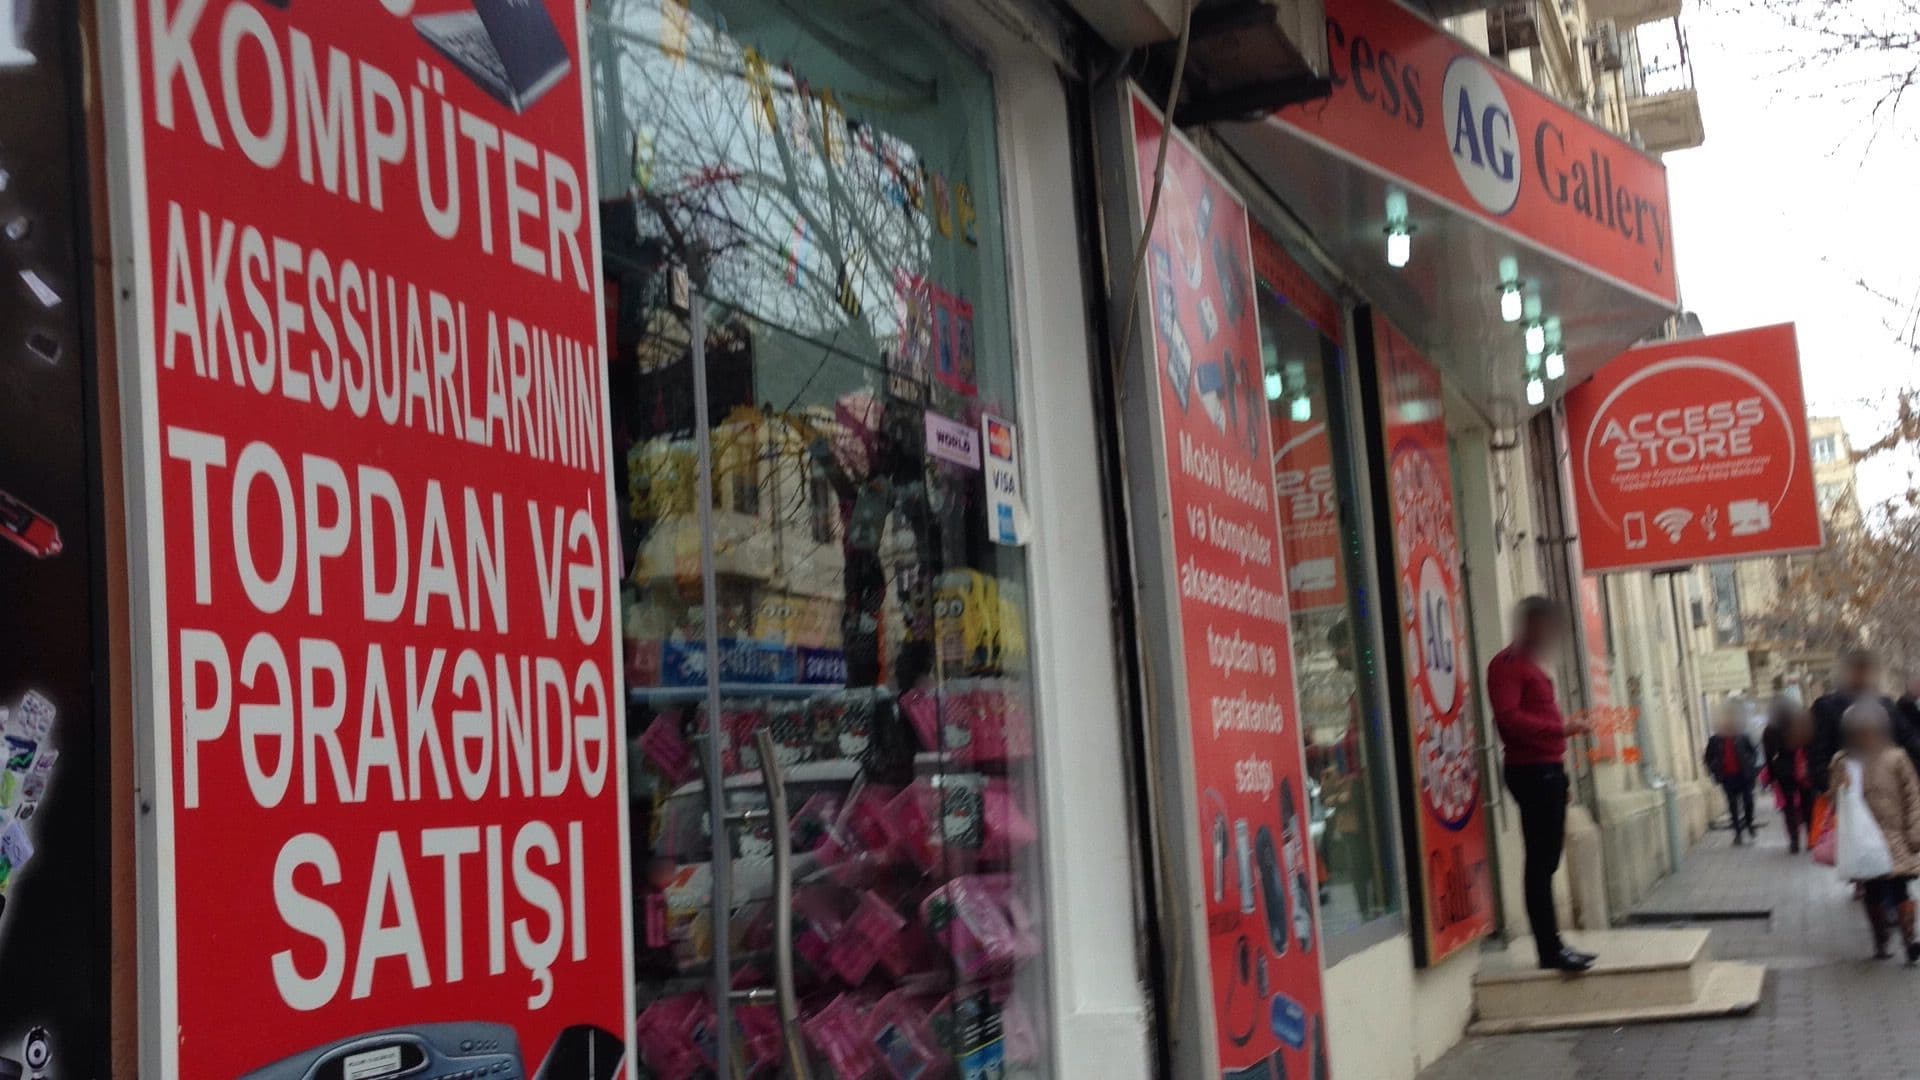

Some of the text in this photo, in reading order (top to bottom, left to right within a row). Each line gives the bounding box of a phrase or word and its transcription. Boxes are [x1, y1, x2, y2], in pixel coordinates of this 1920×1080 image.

[150, 0, 591, 293] KOMPÜTER
[1452, 85, 1515, 184] AG
[1535, 119, 1667, 274] Gallery
[164, 201, 601, 474] AKSESSUARLARININ
[936, 430, 970, 453] WORLD
[1599, 396, 1765, 448] ACCESS
[1613, 427, 1754, 472] STORE
[994, 470, 1016, 495] VISA
[1179, 429, 1221, 489] Mobil
[1222, 457, 1268, 512] telefon
[168, 426, 509, 634] TOPDAN
[1207, 624, 1258, 680] topdan
[1425, 590, 1453, 674] AG
[180, 628, 609, 809] PƏRAKƏNDƏ
[271, 820, 588, 1011] SATIŞI
